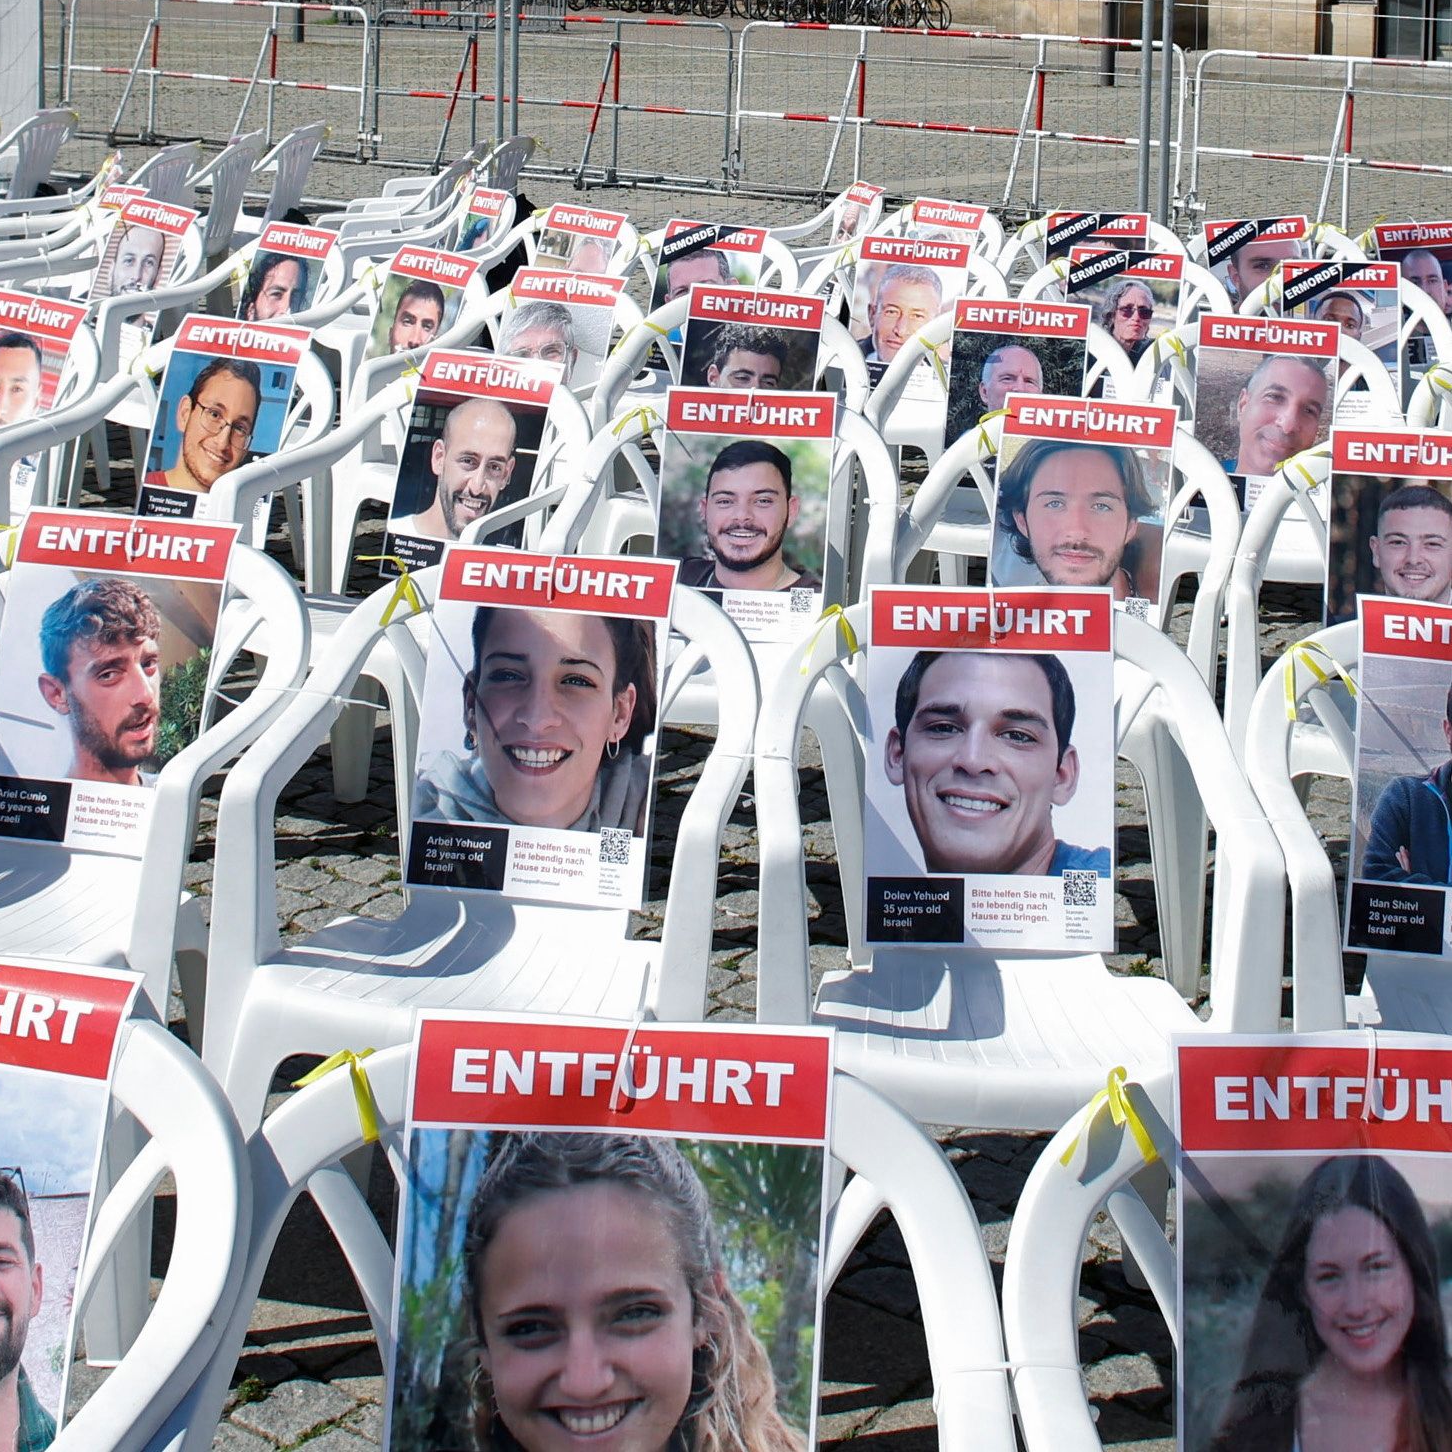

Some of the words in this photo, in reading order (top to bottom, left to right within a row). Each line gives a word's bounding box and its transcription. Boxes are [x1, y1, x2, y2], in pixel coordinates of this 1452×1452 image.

[127, 201, 186, 227] ENTFÜHRT
[919, 207, 978, 223] ENTFÜHRT
[554, 213, 617, 232] ENTFÜHRT
[267, 229, 328, 251] ENTFÜHRT
[870, 242, 957, 261] ENTFÜHRT
[399, 253, 468, 279] ENTFÜHRT
[702, 296, 813, 321] ENTFÜHRT
[966, 306, 1078, 328] ENTFÜHRT
[187, 326, 293, 354] ENTFÜHRT
[1212, 324, 1327, 347] ENTFÜHRT
[433, 362, 544, 394] ENTFÜHRT
[682, 402, 821, 427] ENTFÜHRT
[1019, 406, 1162, 435] ENTFÜHRT
[37, 525, 215, 564] ENTFÜHRT
[461, 561, 654, 601] ENTFÜHRT
[892, 604, 1091, 636] ENTFÜHRT
[19, 790, 48, 802] Cunio
[7, 803, 33, 815] years
[35, 804, 50, 815] old
[426, 836, 453, 847] Arbel
[456, 838, 492, 850] Yehuod
[515, 840, 535, 849] Bitte
[536, 842, 561, 853] helfen
[563, 844, 577, 854] Sie
[425, 849, 437, 858] 28
[439, 851, 466, 862] years
[468, 852, 483, 862] old
[514, 851, 527, 859] sie
[528, 852, 564, 864] lebendig
[565, 856, 585, 866] nach
[424, 861, 454, 872] Israeli
[513, 862, 539, 873] Hause
[540, 865, 550, 873] zu
[883, 891, 911, 901] Dolev
[913, 891, 950, 902] Yehuod
[972, 890, 992, 899] Bitte
[994, 890, 1021, 900] helfen
[1023, 890, 1038, 900] Sie
[883, 905, 895, 914] 35
[897, 906, 924, 916] years
[926, 905, 941, 914] old
[972, 901, 985, 909] sie
[987, 901, 1024, 912] lebendig
[1026, 902, 1047, 911] nach
[1369, 898, 1390, 909] Idan
[883, 918, 913, 928] Israeli
[971, 913, 999, 921] Hause
[1369, 911, 1380, 921] 28
[1380, 913, 1408, 925] years
[1410, 915, 1425, 925] old
[1367, 924, 1396, 936] Israeli
[451, 1045, 794, 1108] ENTFÜHRT
